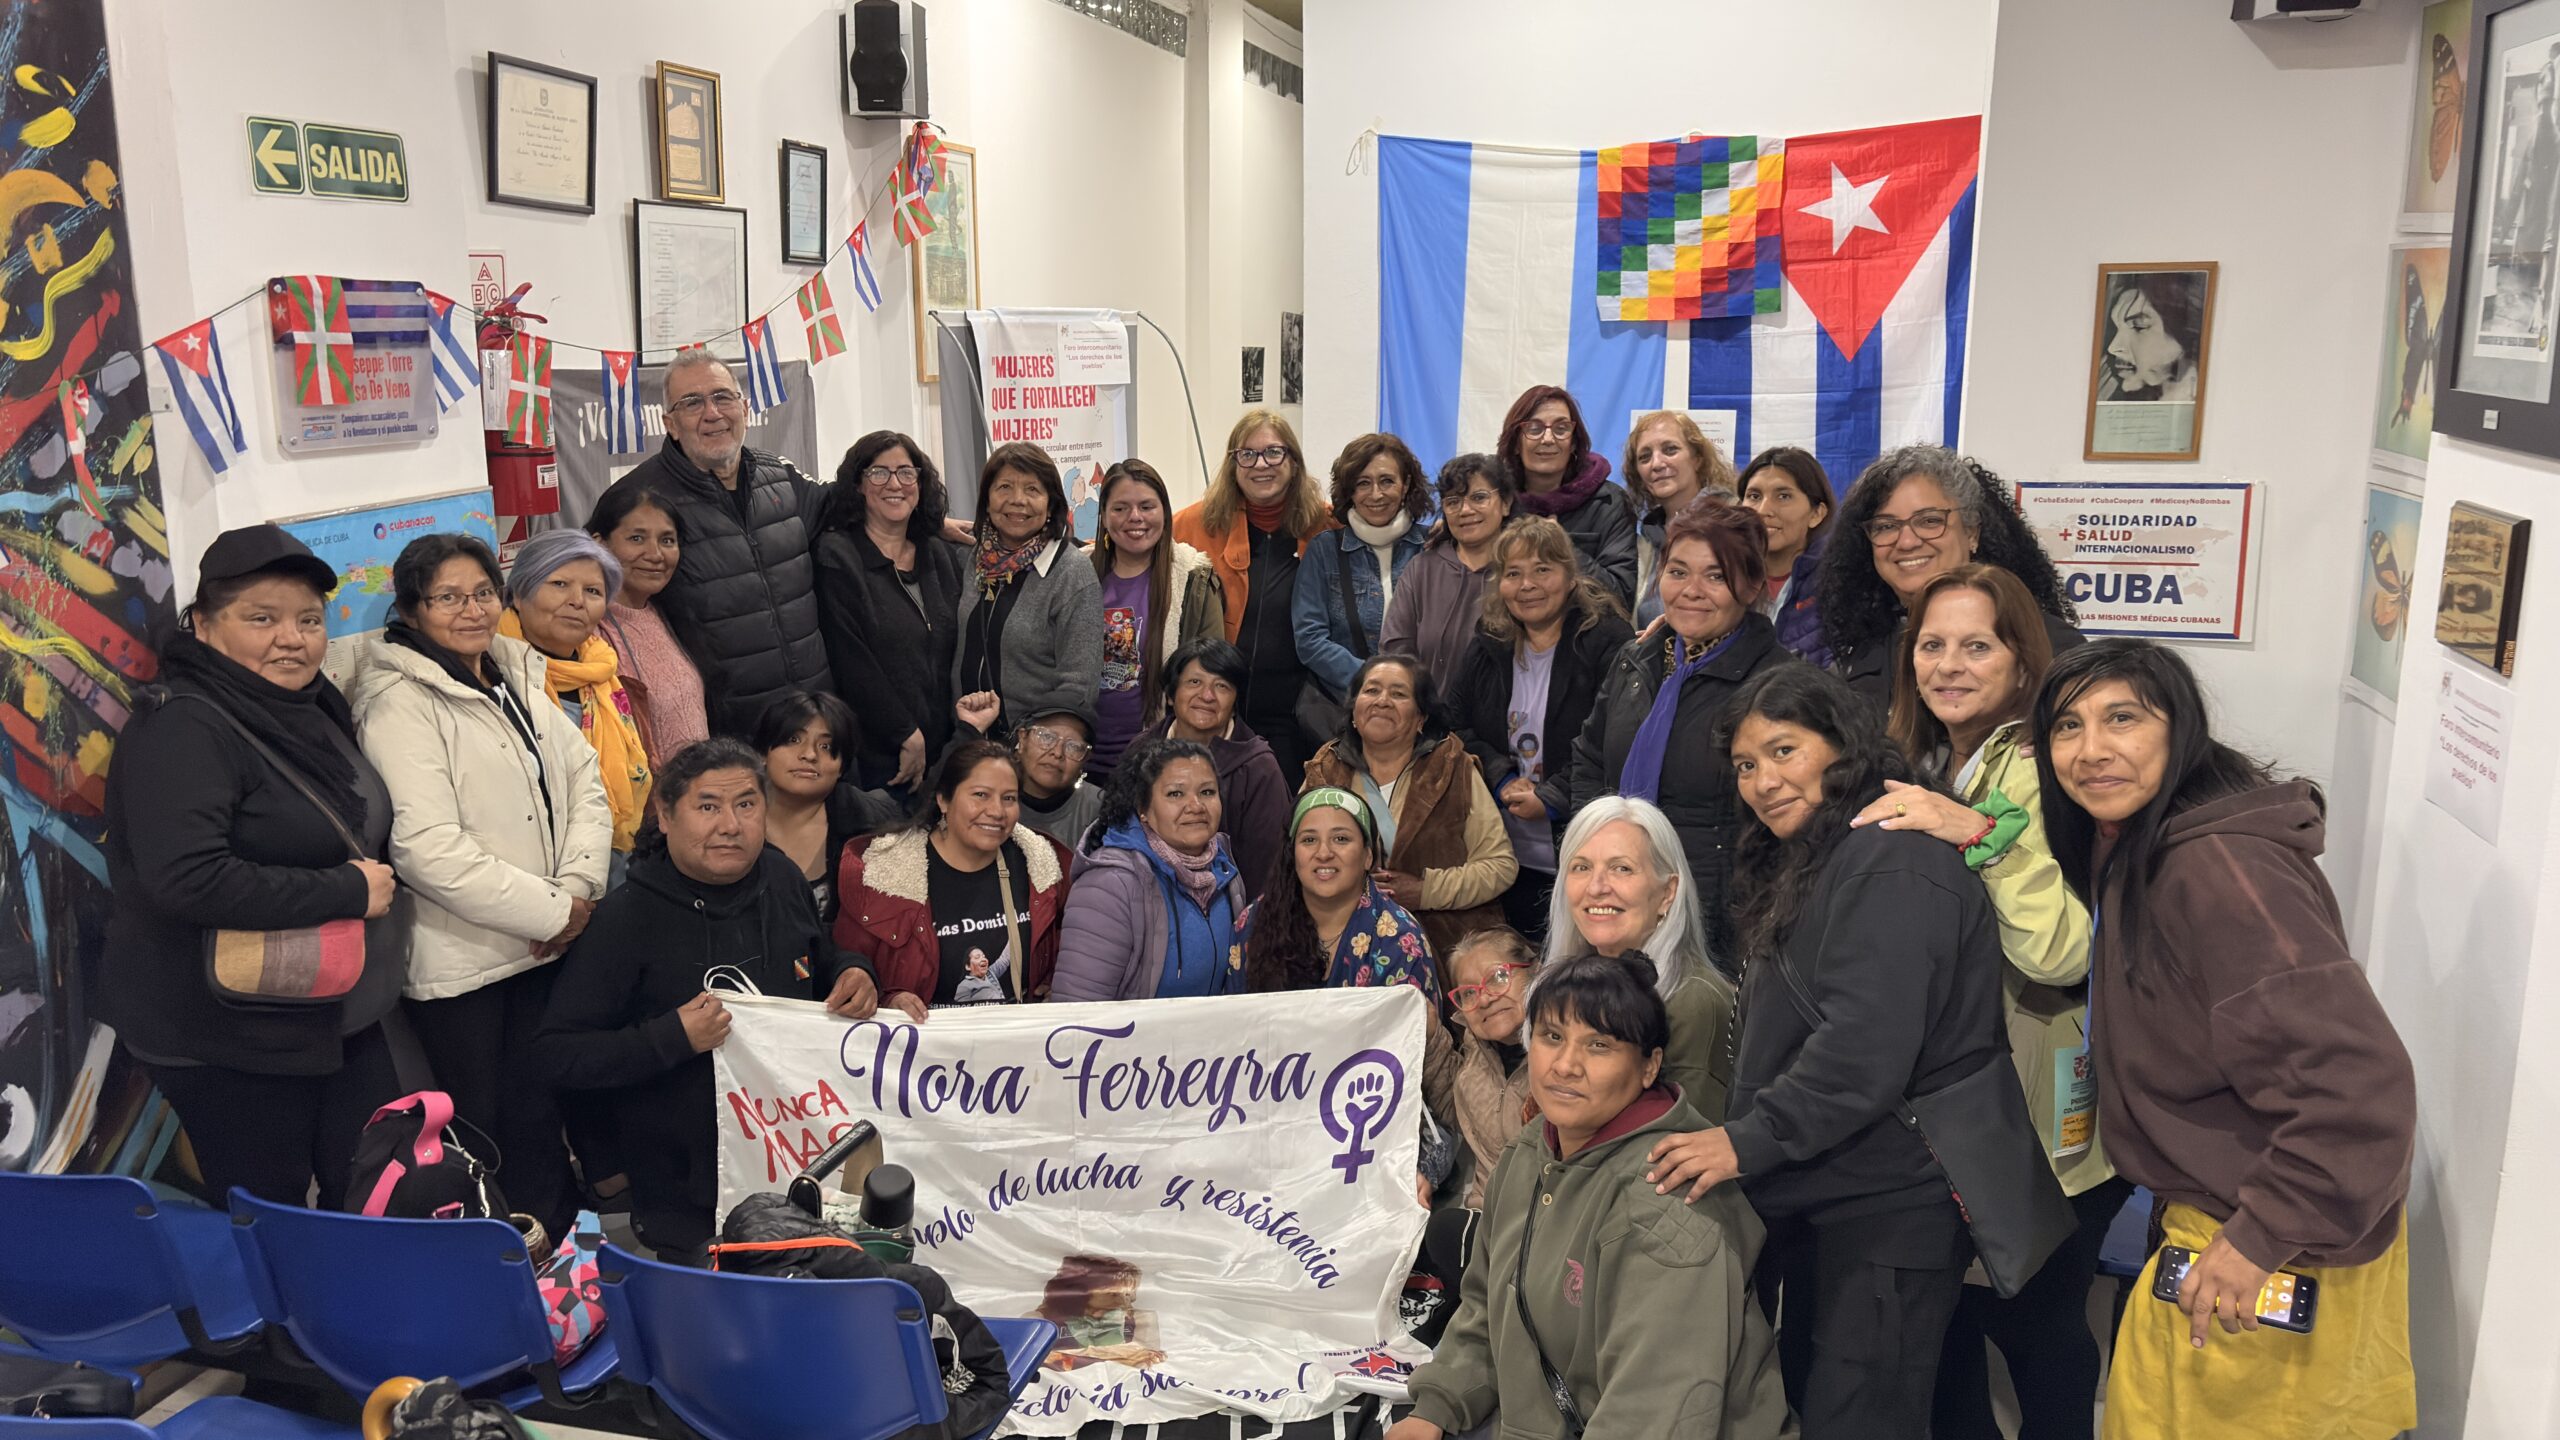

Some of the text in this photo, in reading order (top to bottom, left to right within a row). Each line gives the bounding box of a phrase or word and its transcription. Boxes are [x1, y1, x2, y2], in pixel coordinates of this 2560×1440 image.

[310, 143, 403, 185] SALIDA
[353, 351, 413, 378] seppe Torre
[991, 354, 1055, 379] "MUJERES
[354, 378, 411, 401] sa De Vena
[991, 385, 1096, 413] QUE FORTALECEN
[992, 417, 1058, 442] MUJERES"
[1046, 442, 1068, 452] circular
[1069, 442, 1084, 450] entre
[2090, 497, 2144, 505] #CubaCoopera
[2077, 514, 2197, 527] SOLIDARIDAD
[2076, 529, 2133, 542] SALUD
[2074, 544, 2195, 555] INTERNACIONALISMO
[2066, 572, 2183, 605] CUBA
[2097, 613, 2139, 622] MISIONES
[2140, 613, 2178, 623] MÉDICAS
[2180, 616, 2221, 624] CUBANAS
[961, 911, 1031, 933] Domitas
[840, 1020, 1315, 1132] Nora Ferreyra
[727, 1079, 849, 1140] NUNCA
[988, 1168, 1030, 1213] de
[1036, 1152, 1143, 1197] lucha
[1160, 1174, 1186, 1212] y
[1202, 1180, 1343, 1290] resistencia
